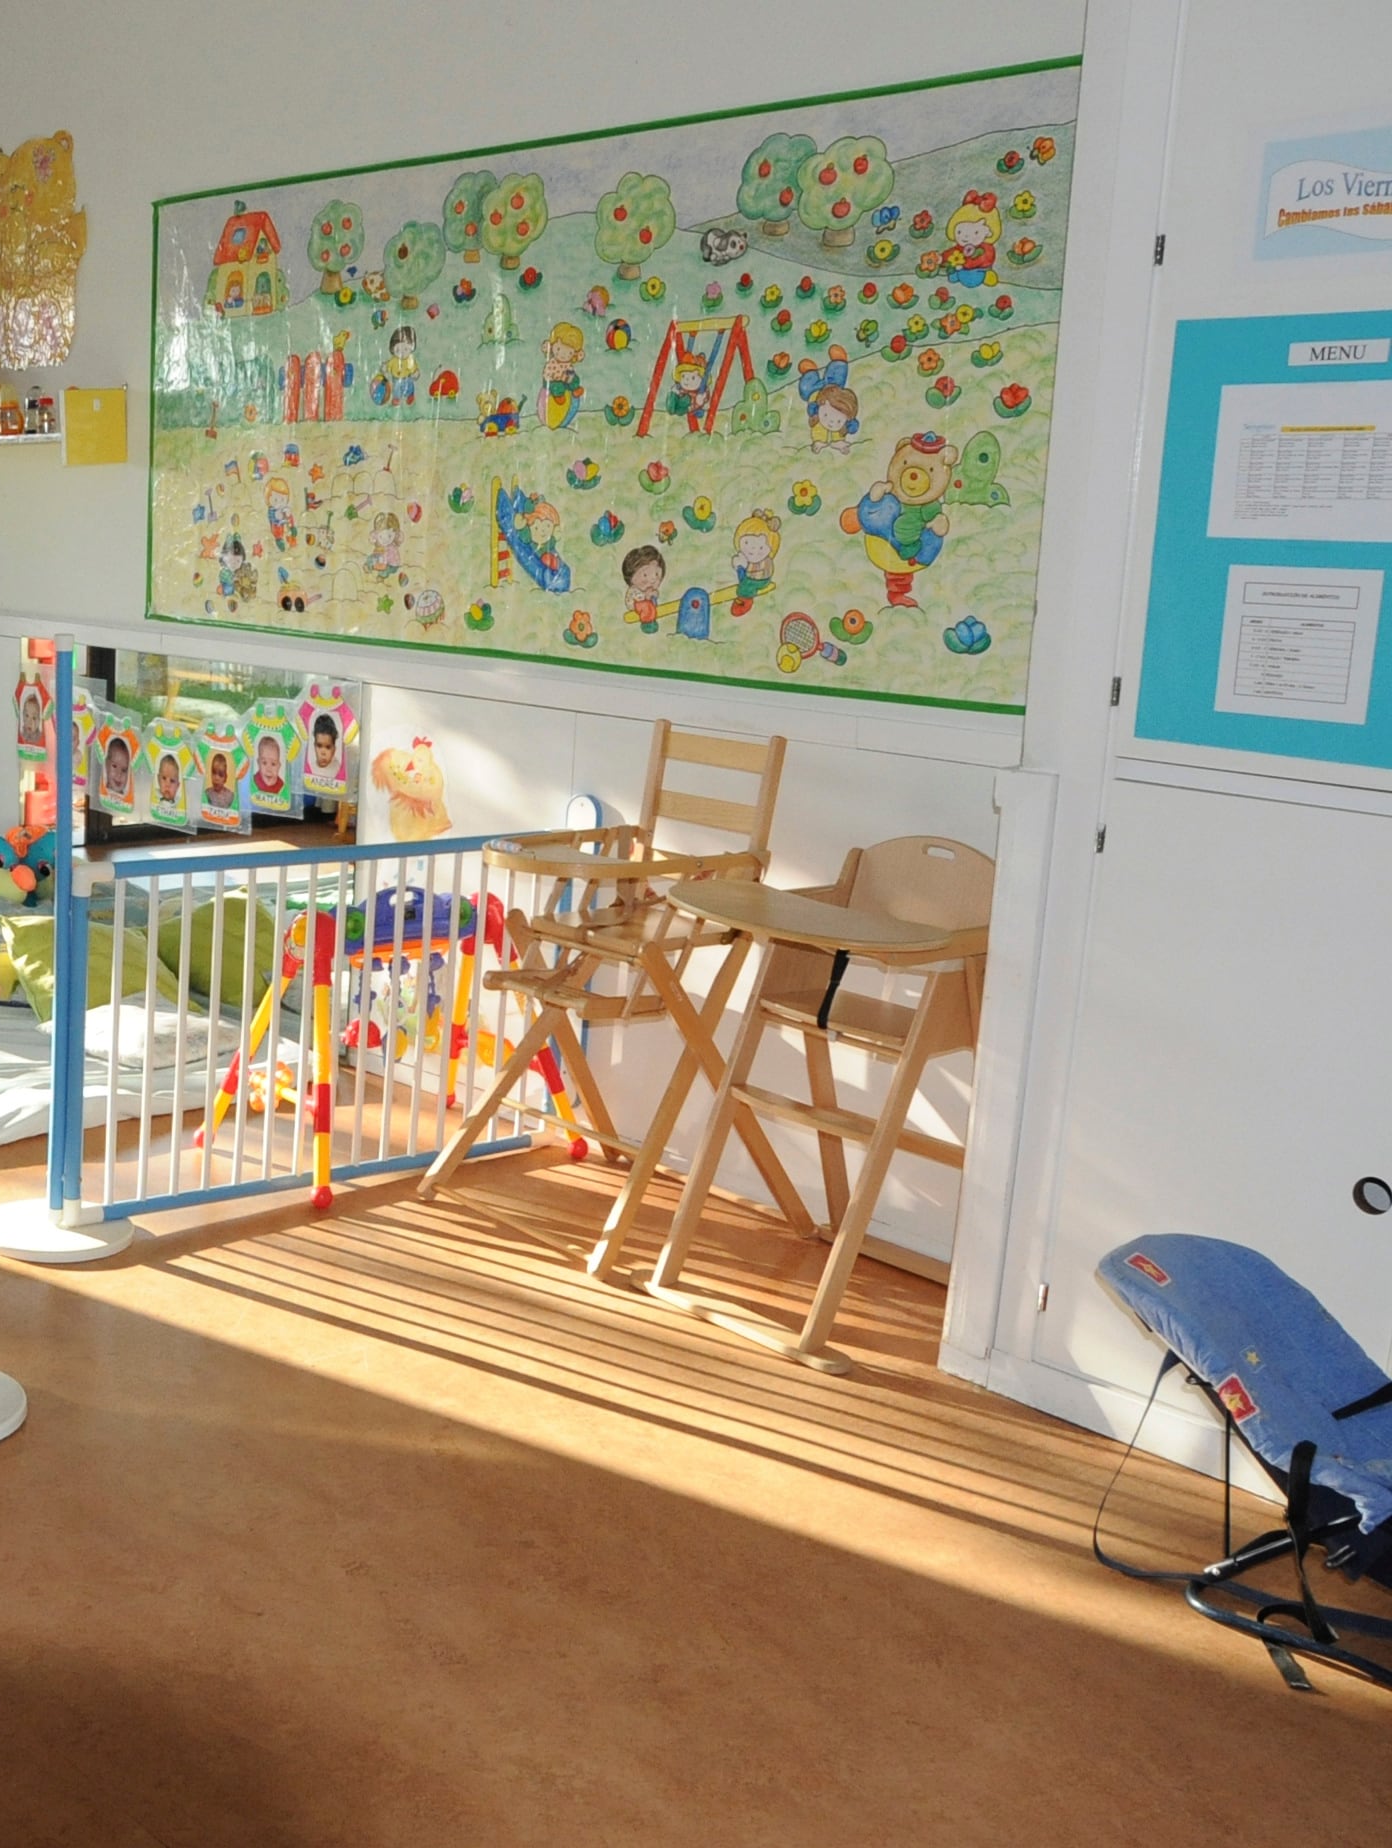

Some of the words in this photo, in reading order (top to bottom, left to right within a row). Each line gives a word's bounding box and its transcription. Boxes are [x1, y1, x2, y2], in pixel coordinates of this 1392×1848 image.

[1296, 177, 1334, 201] Los
[1277, 208, 1340, 227] Cambiamos
[1309, 344, 1367, 361] MENU
[311, 777, 339, 788] ANDREA
